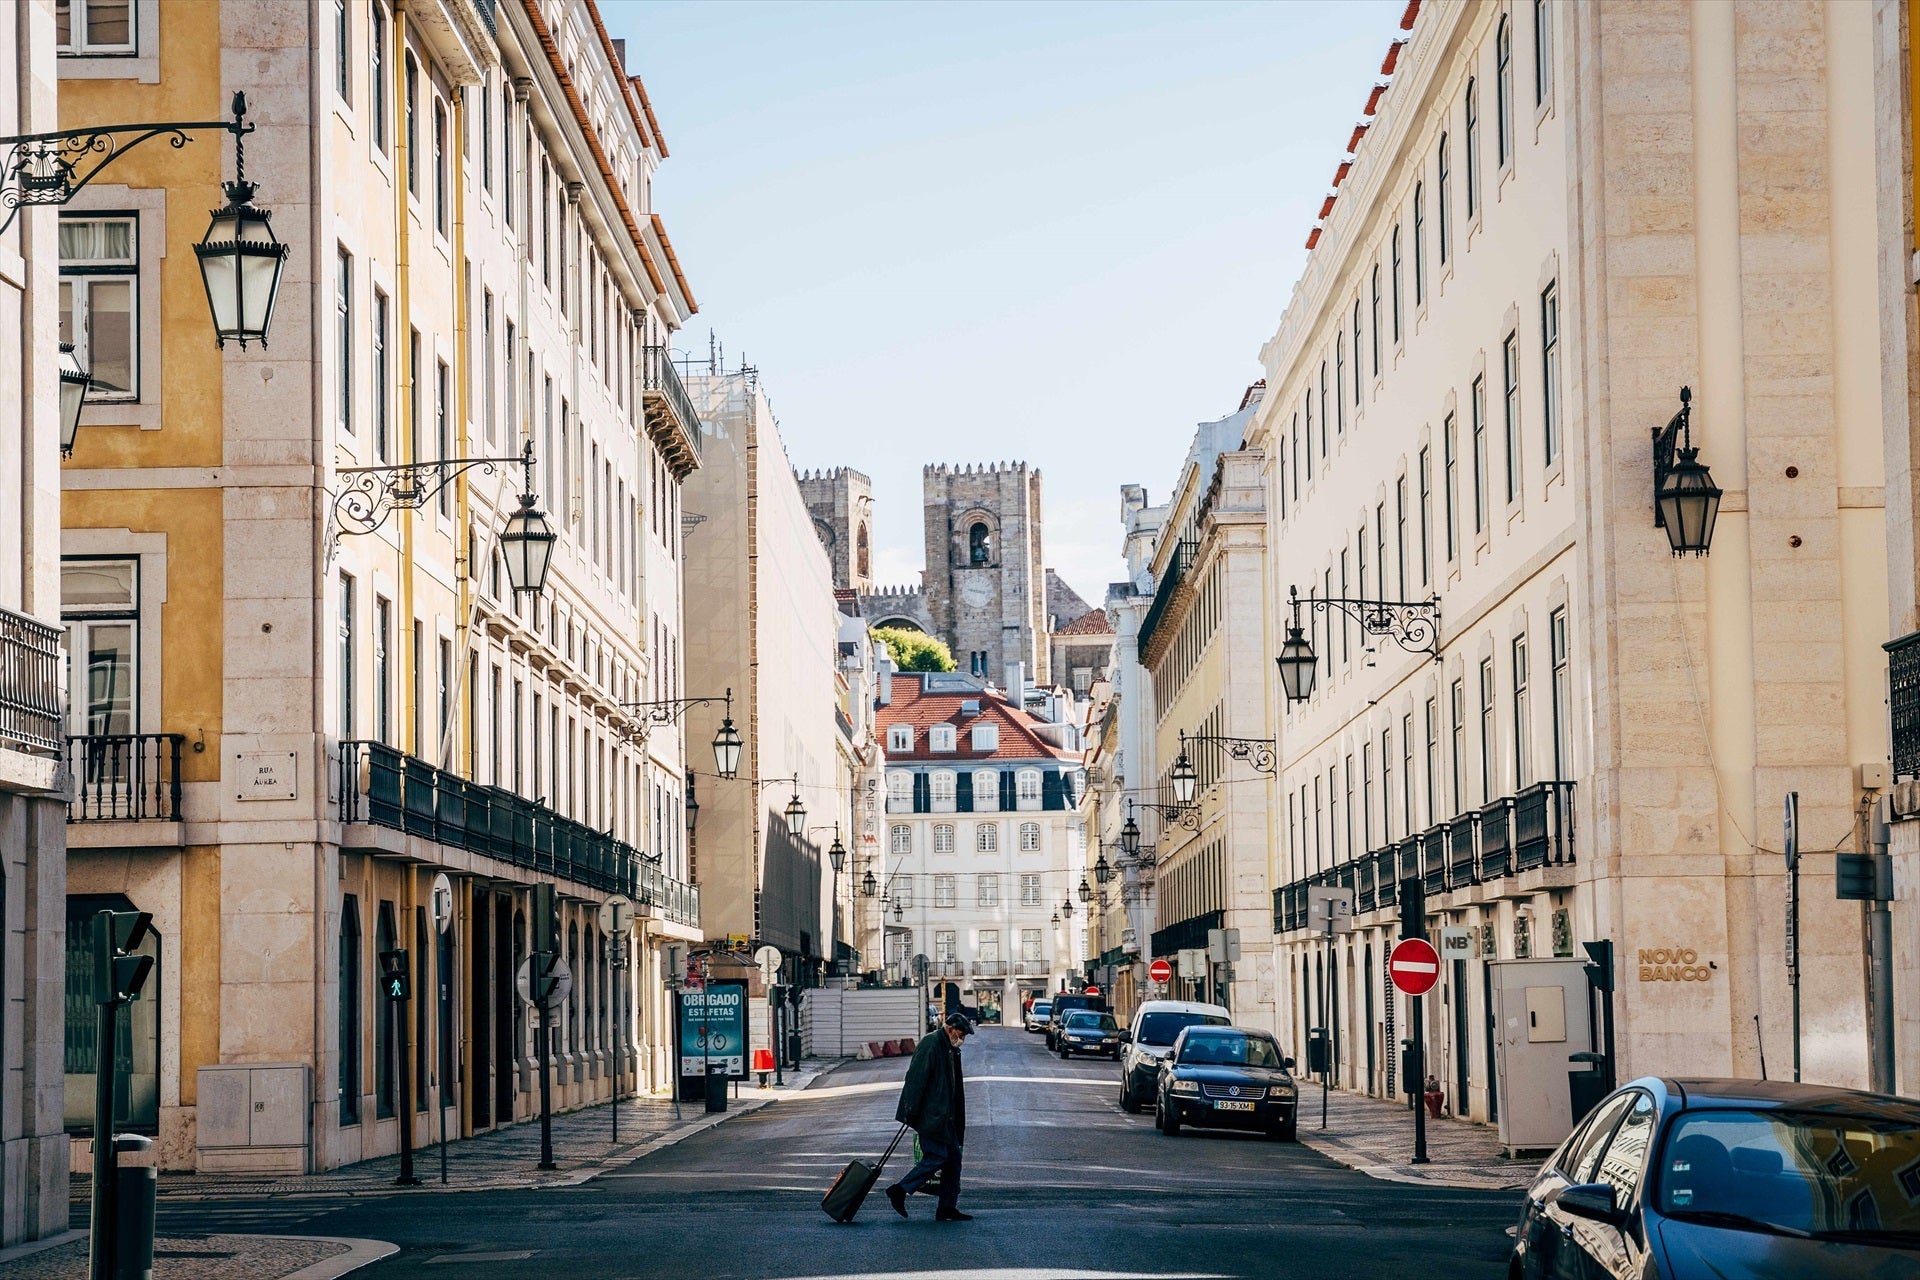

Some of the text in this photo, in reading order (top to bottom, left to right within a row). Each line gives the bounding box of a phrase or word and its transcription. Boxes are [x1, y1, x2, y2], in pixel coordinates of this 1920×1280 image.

[1445, 937, 1468, 949] NB
[1638, 949, 1697, 964] NOVO
[1638, 966, 1711, 981] BANCO
[684, 994, 739, 1006] OBRIGADO
